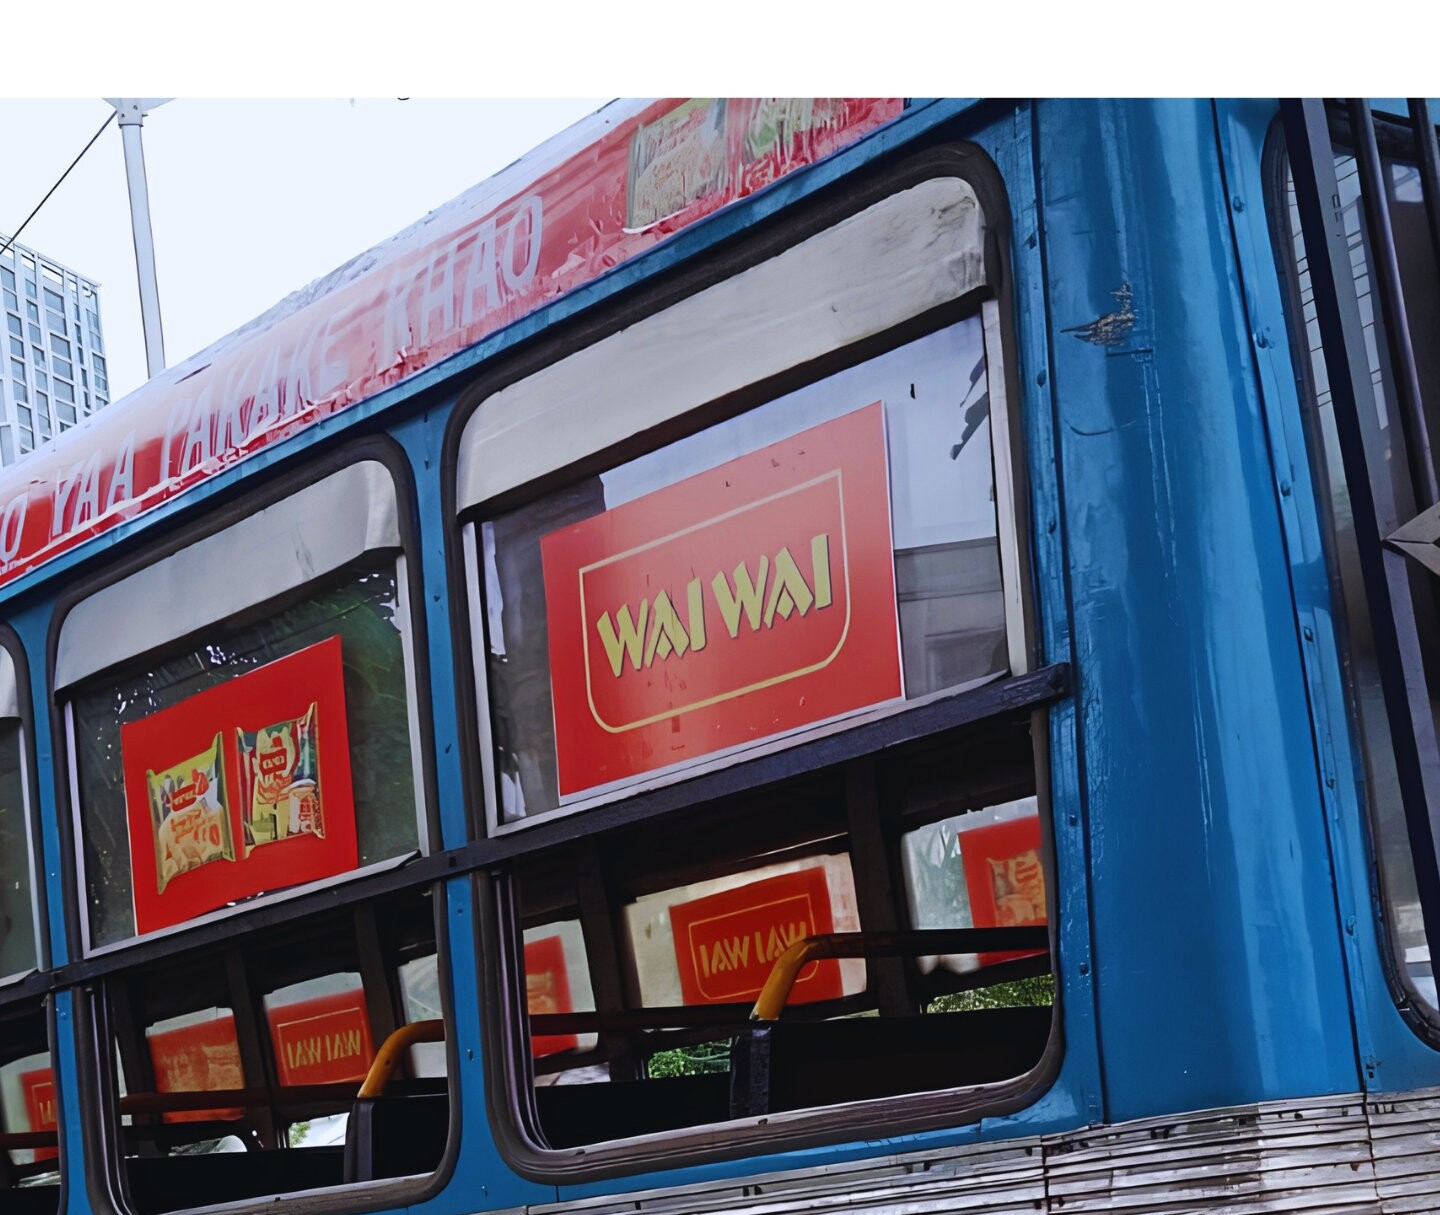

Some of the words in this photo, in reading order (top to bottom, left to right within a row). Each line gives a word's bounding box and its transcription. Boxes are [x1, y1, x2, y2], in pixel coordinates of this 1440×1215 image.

[48, 428, 136, 536] YAA
[385, 195, 544, 367] KHAO
[596, 576, 707, 679] WAI
[711, 532, 832, 639] WAI
